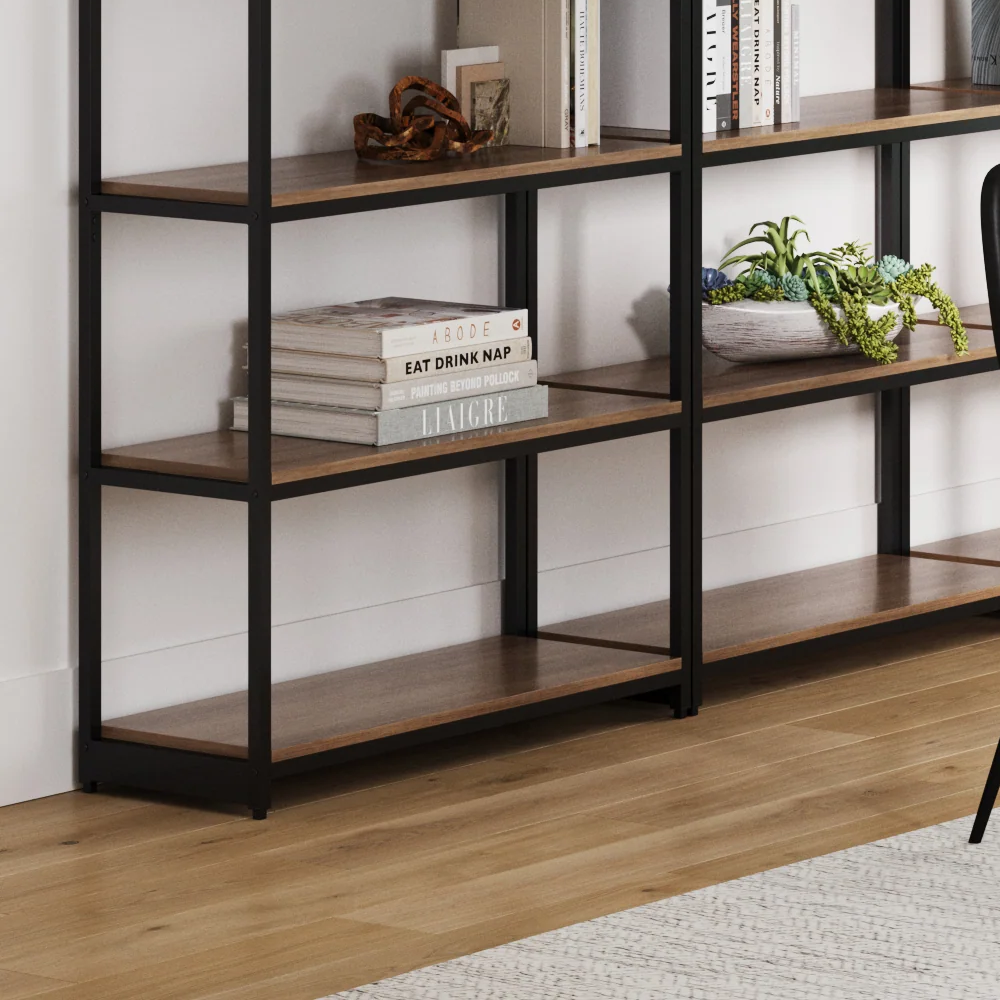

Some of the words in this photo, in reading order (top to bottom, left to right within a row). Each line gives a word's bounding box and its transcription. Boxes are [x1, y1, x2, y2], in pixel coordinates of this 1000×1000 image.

[740, 0, 752, 86] LIAIGRE
[432, 321, 490, 344] ABODE
[405, 359, 431, 375] EAT
[435, 351, 478, 370] DRINK
[483, 346, 511, 362] NAP
[410, 382, 448, 400] PAINTING
[450, 377, 482, 393] BEYOND
[484, 370, 520, 387] POLLOCK
[422, 395, 508, 436] LIAIGRE
